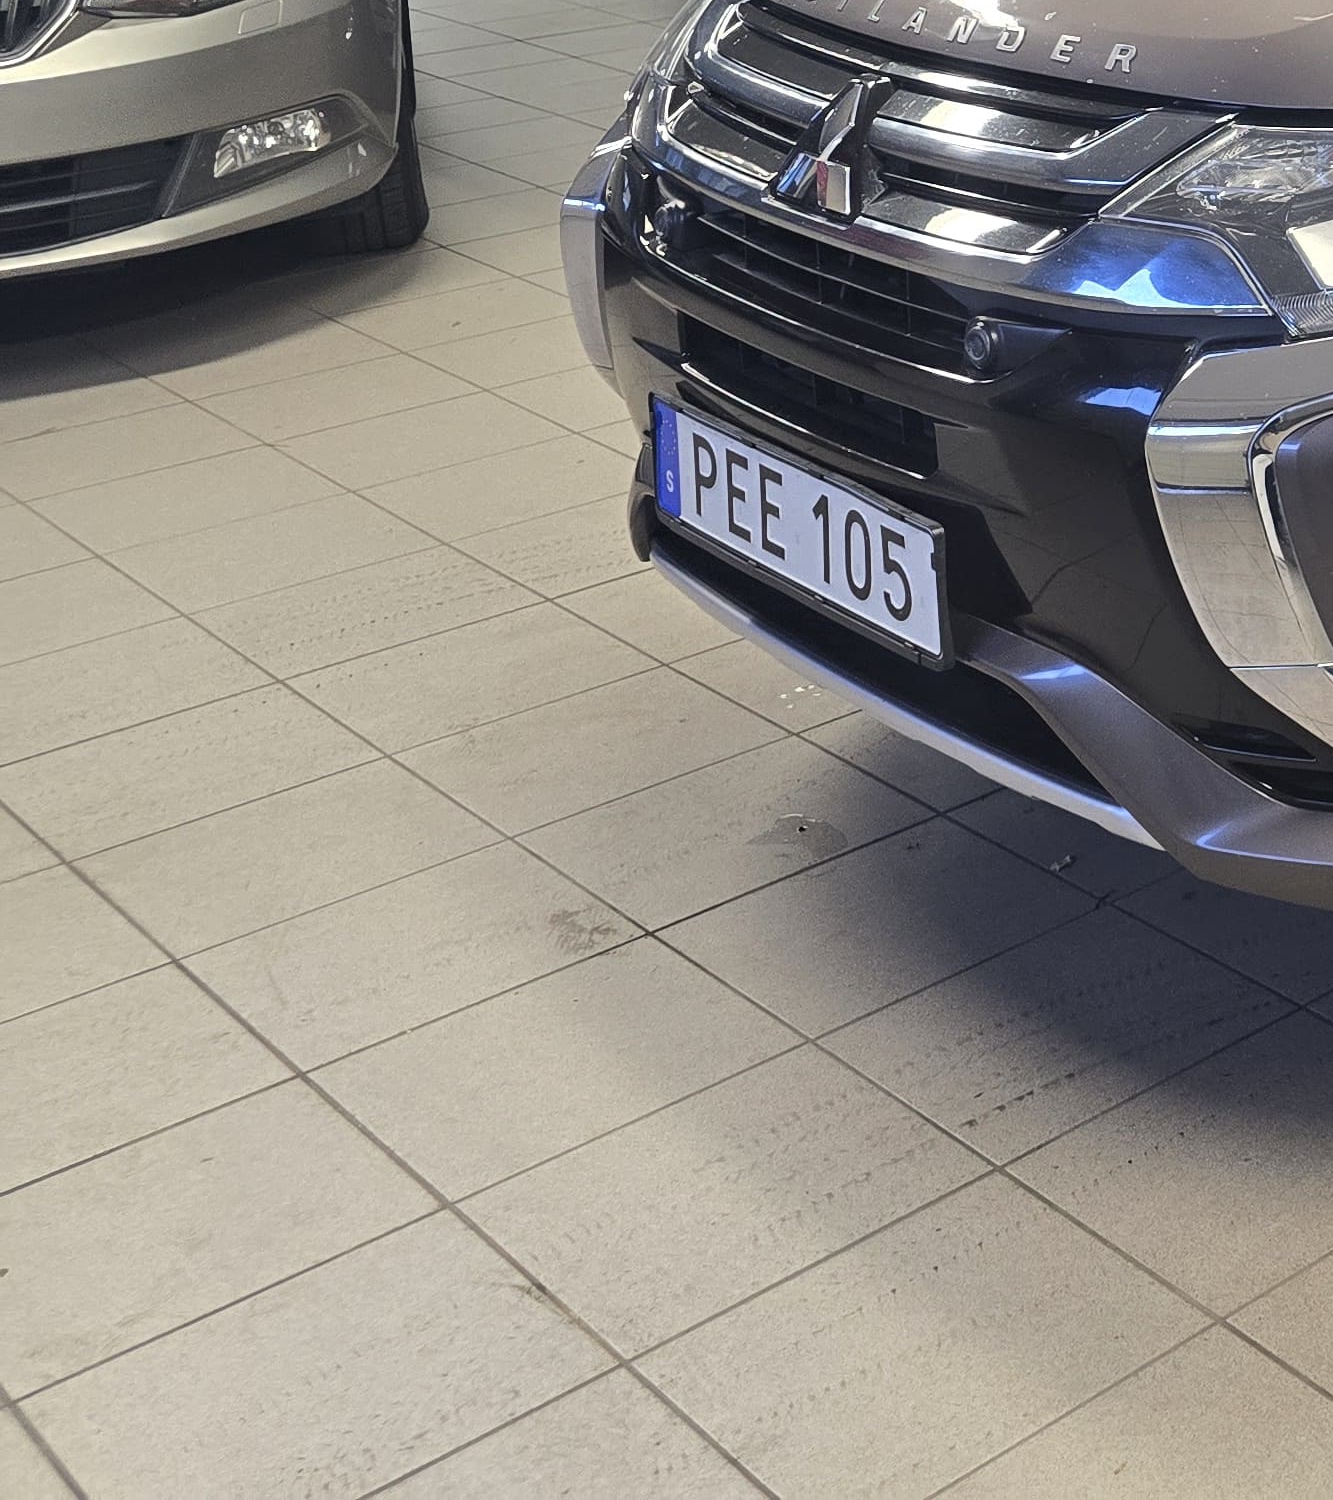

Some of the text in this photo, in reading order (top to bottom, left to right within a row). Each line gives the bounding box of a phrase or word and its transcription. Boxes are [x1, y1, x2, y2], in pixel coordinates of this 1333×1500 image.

[665, 432, 913, 622] S PEE 105
